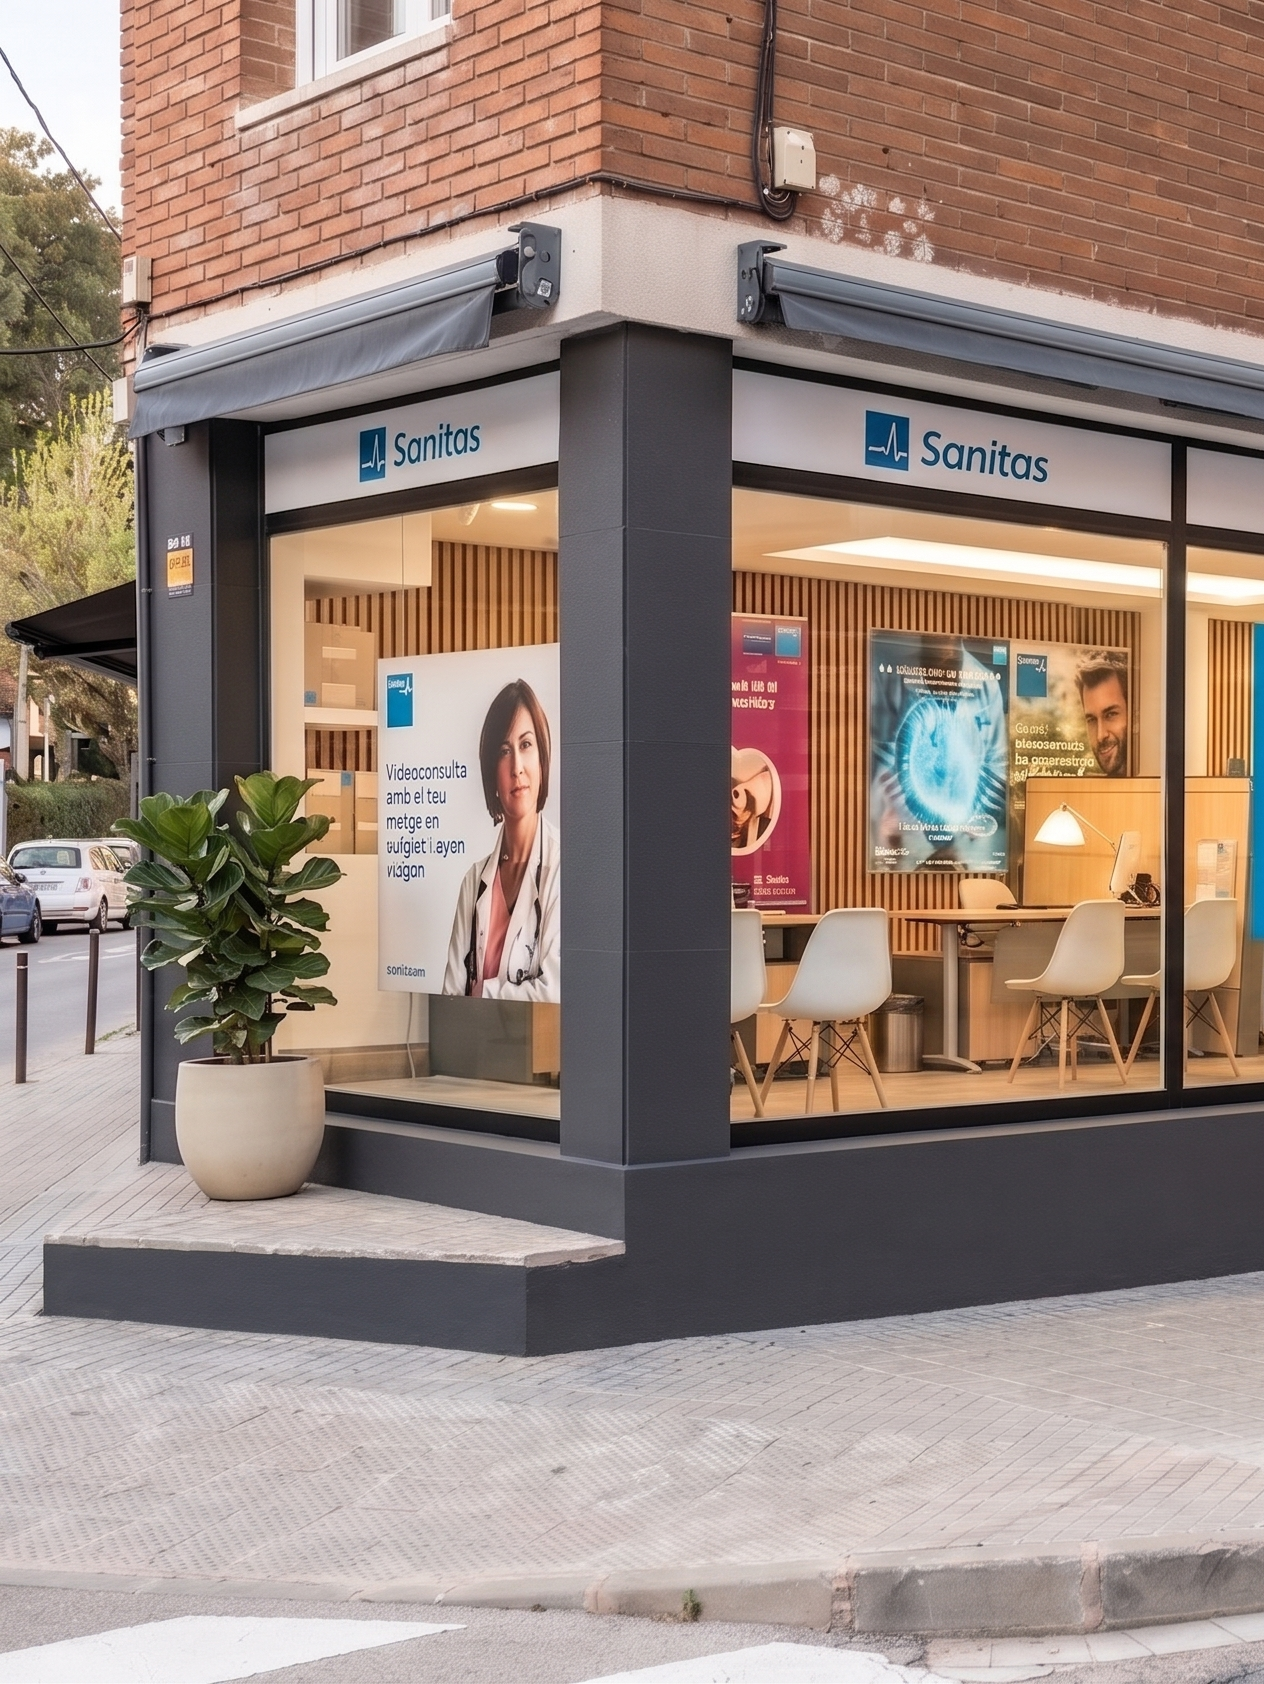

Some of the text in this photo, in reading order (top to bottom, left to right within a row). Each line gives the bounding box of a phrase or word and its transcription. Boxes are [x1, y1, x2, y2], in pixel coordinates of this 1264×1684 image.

[393, 423, 481, 467] Sanitas
[920, 430, 1049, 483] Sanitas
[385, 759, 467, 781] Videoconsulta
[386, 786, 447, 805] amb el teu
[386, 812, 439, 834] metge en
